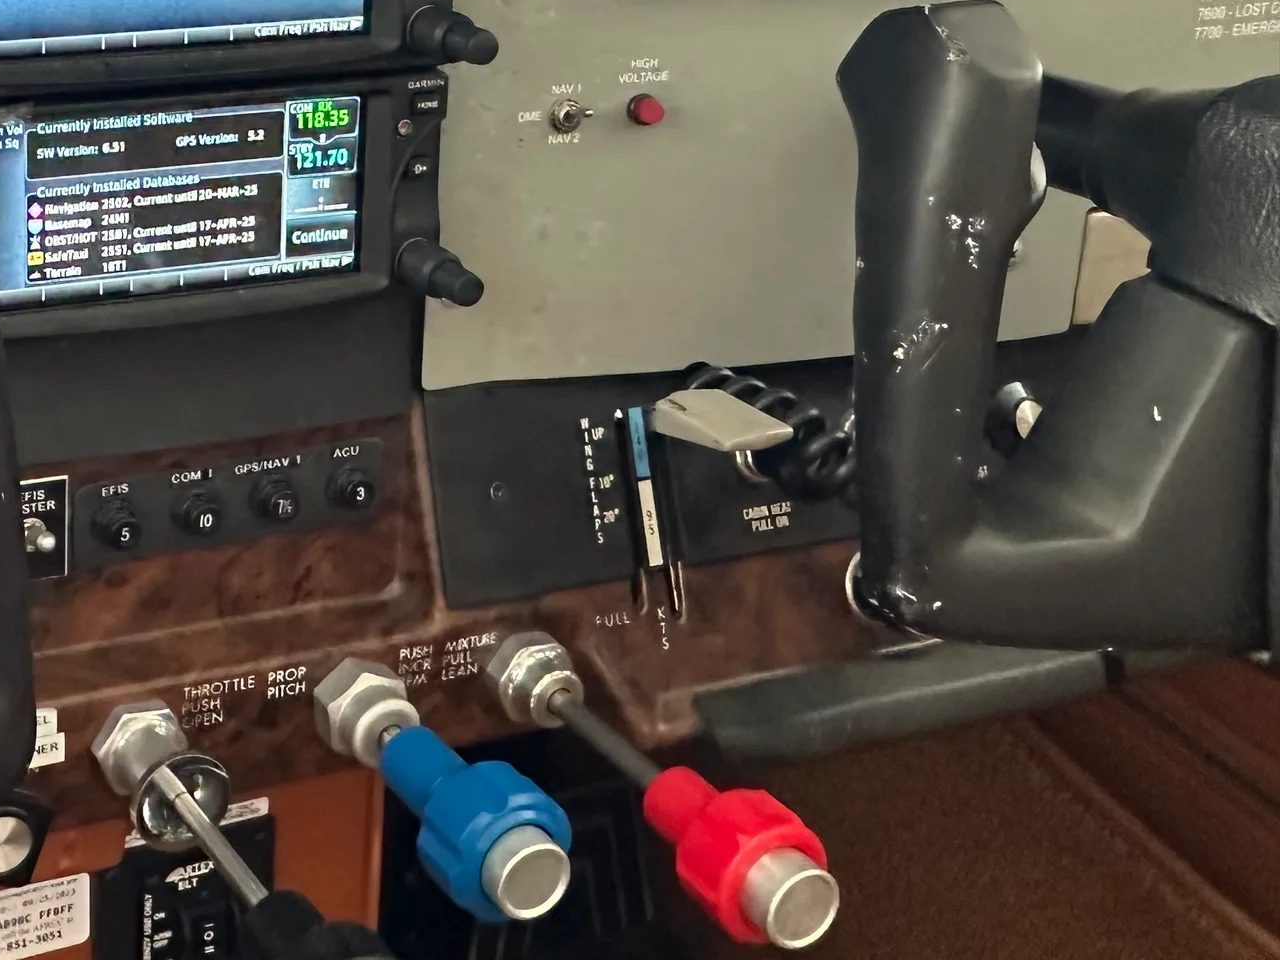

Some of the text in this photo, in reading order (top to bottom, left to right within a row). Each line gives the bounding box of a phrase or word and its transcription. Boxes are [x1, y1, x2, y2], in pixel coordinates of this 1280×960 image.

[1235, 2, 1268, 17] LOST
[631, 57, 659, 69] HIGH
[618, 71, 669, 85] VOLTAGE
[551, 84, 575, 95] NAV
[37, 110, 194, 136] Currently Installed Software
[296, 109, 350, 130] 118.35
[518, 111, 543, 122] DME
[548, 132, 580, 145] NAV 2
[294, 151, 349, 171] 121.70
[37, 174, 201, 199] Currently Installed Databases
[291, 226, 349, 245] Continue
[332, 445, 360, 459] ACU
[234, 454, 301, 476] GPS/NAV 1
[171, 470, 202, 485] COM
[101, 482, 130, 497] EFIS
[444, 631, 498, 652] MIXTURE
[442, 649, 474, 666] PULL
[440, 662, 479, 682] LEAN
[182, 667, 307, 699] THROTTLE PROP
[181, 680, 307, 714] PUSH PITCH
[181, 711, 224, 730] OPEN
